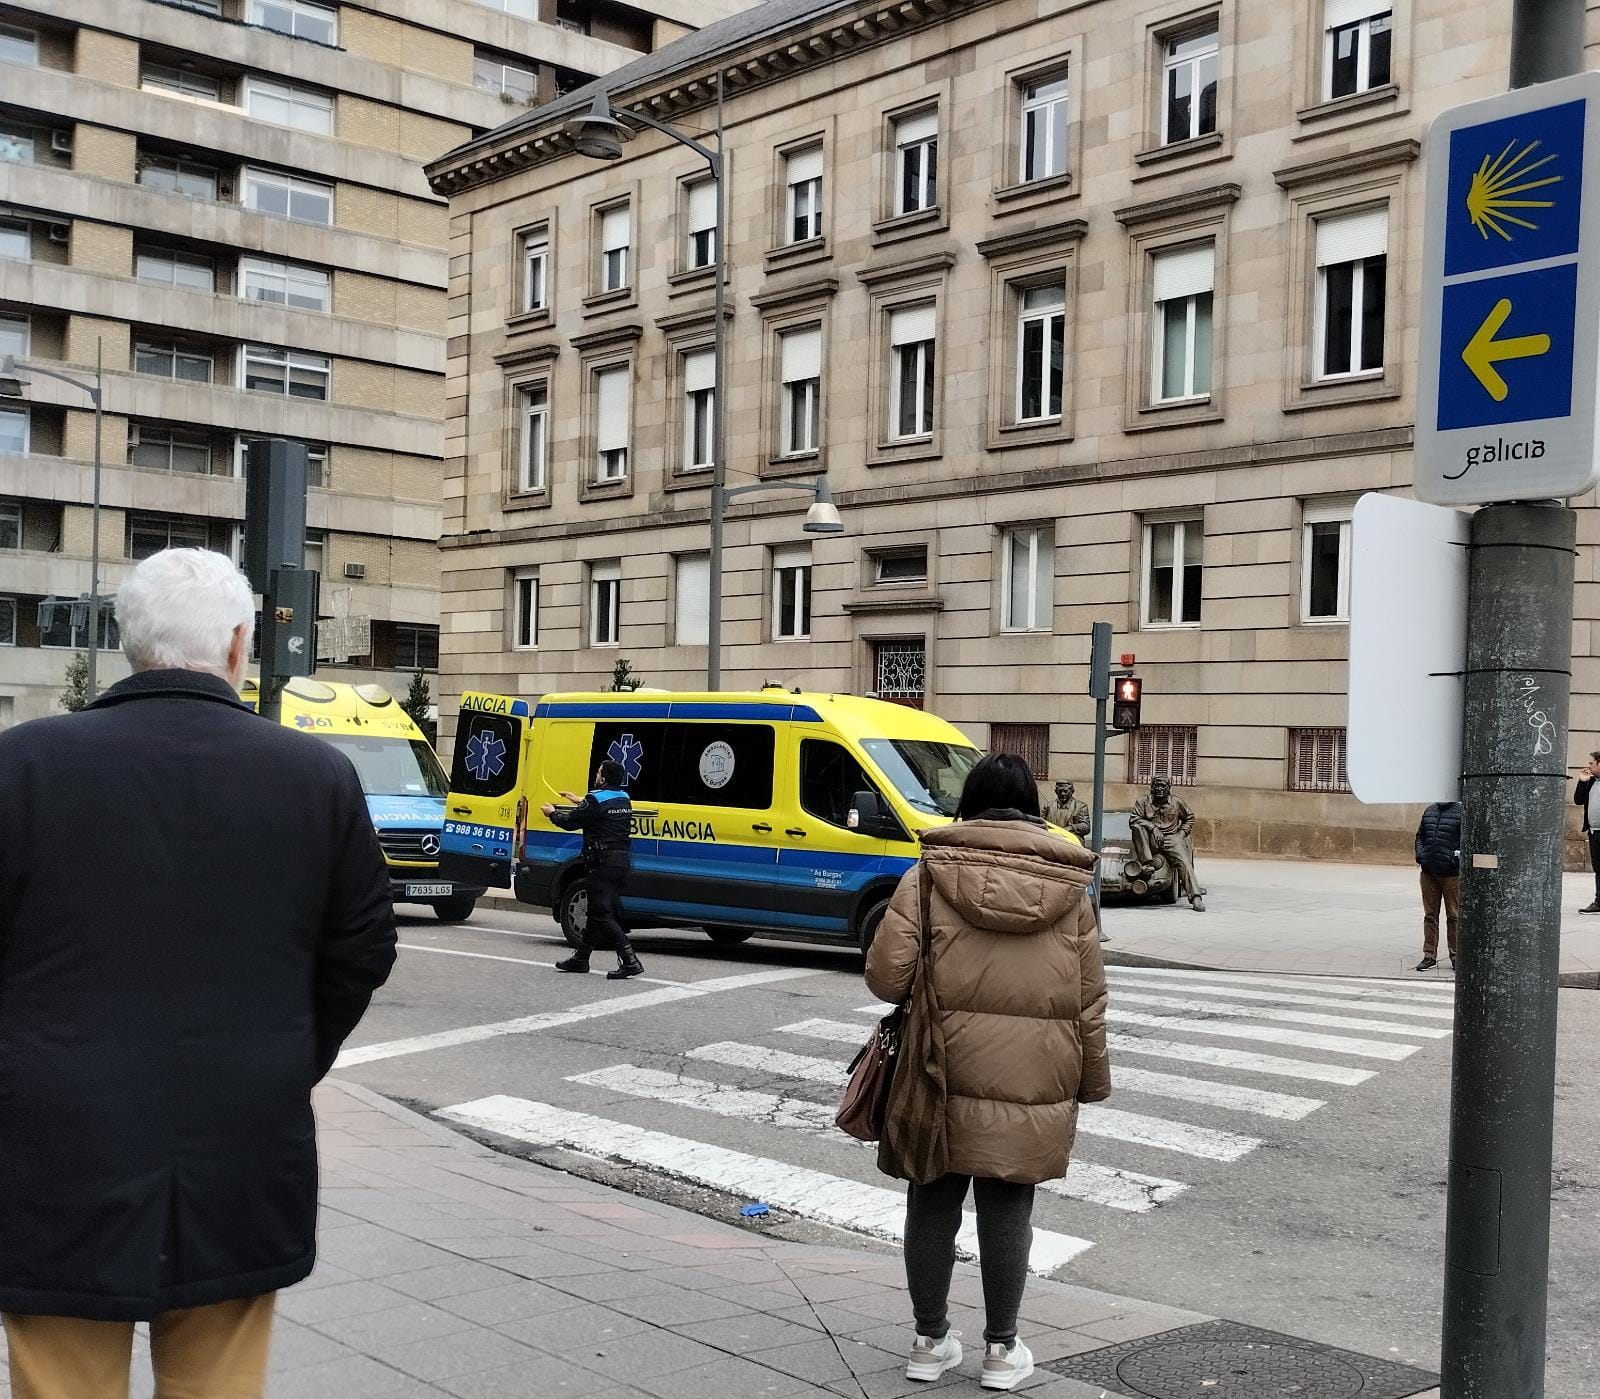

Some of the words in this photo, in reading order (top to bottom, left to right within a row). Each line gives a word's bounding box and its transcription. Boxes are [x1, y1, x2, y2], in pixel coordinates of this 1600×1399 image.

[1443, 438, 1546, 480] galicia
[461, 695, 506, 714] ANCIA
[455, 824, 472, 835] 988
[472, 827, 483, 837] 36
[485, 828, 496, 839] 61
[498, 830, 510, 841] 51
[630, 818, 716, 842] BULANCIA
[411, 886, 433, 895] 7635
